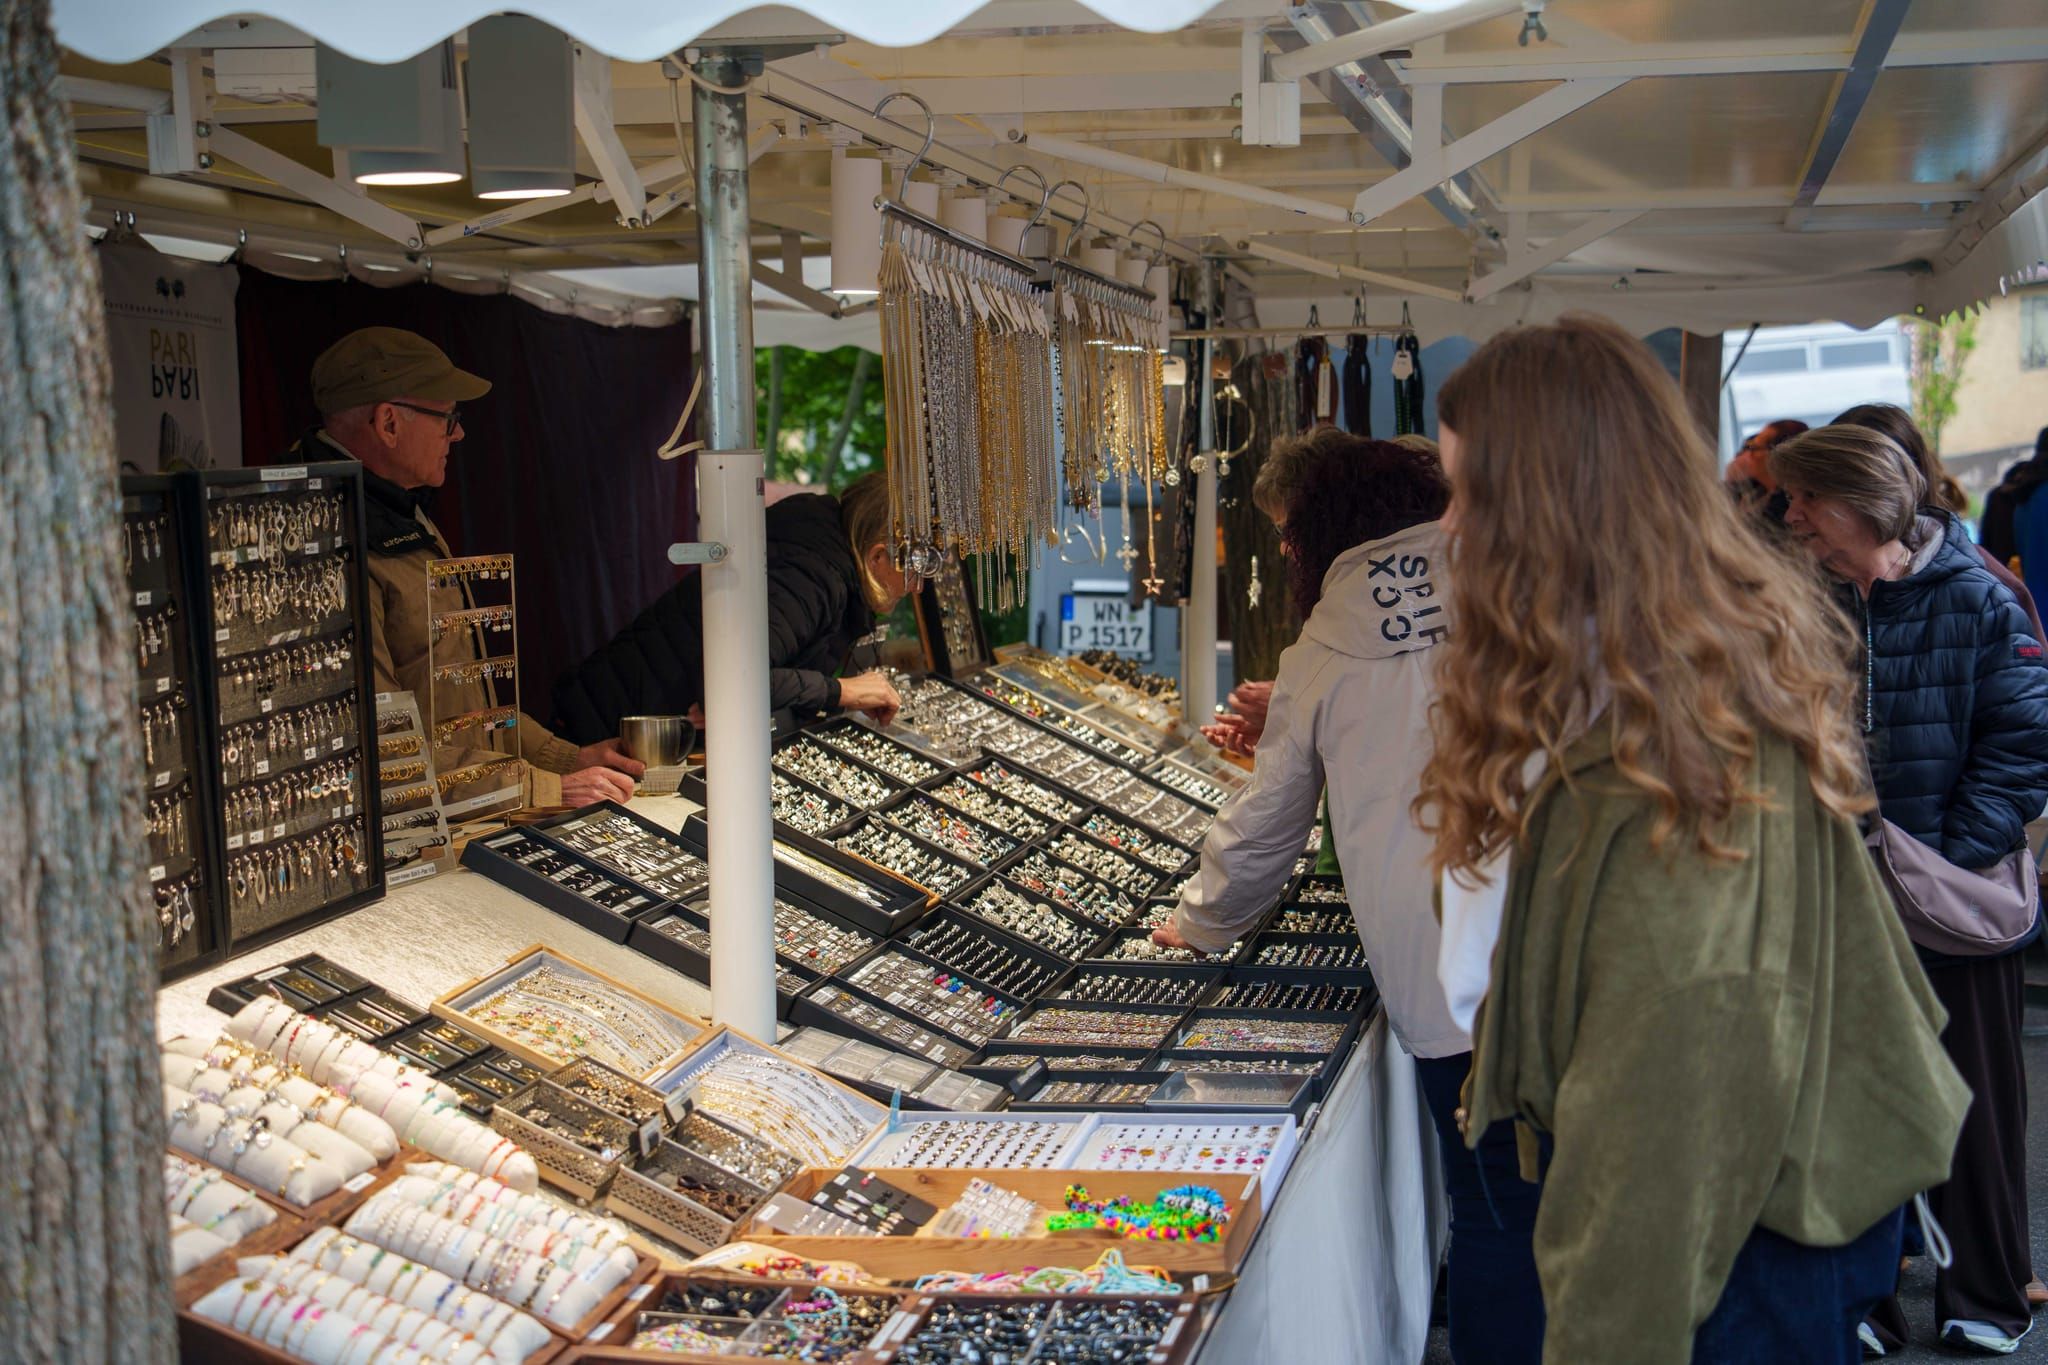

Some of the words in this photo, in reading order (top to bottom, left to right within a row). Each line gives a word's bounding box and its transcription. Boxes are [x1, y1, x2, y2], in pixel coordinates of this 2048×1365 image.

[150, 328, 197, 368] PARI
[1094, 601, 1122, 622] WN
[1069, 625, 1082, 646] P
[1088, 625, 1144, 647] 1517
